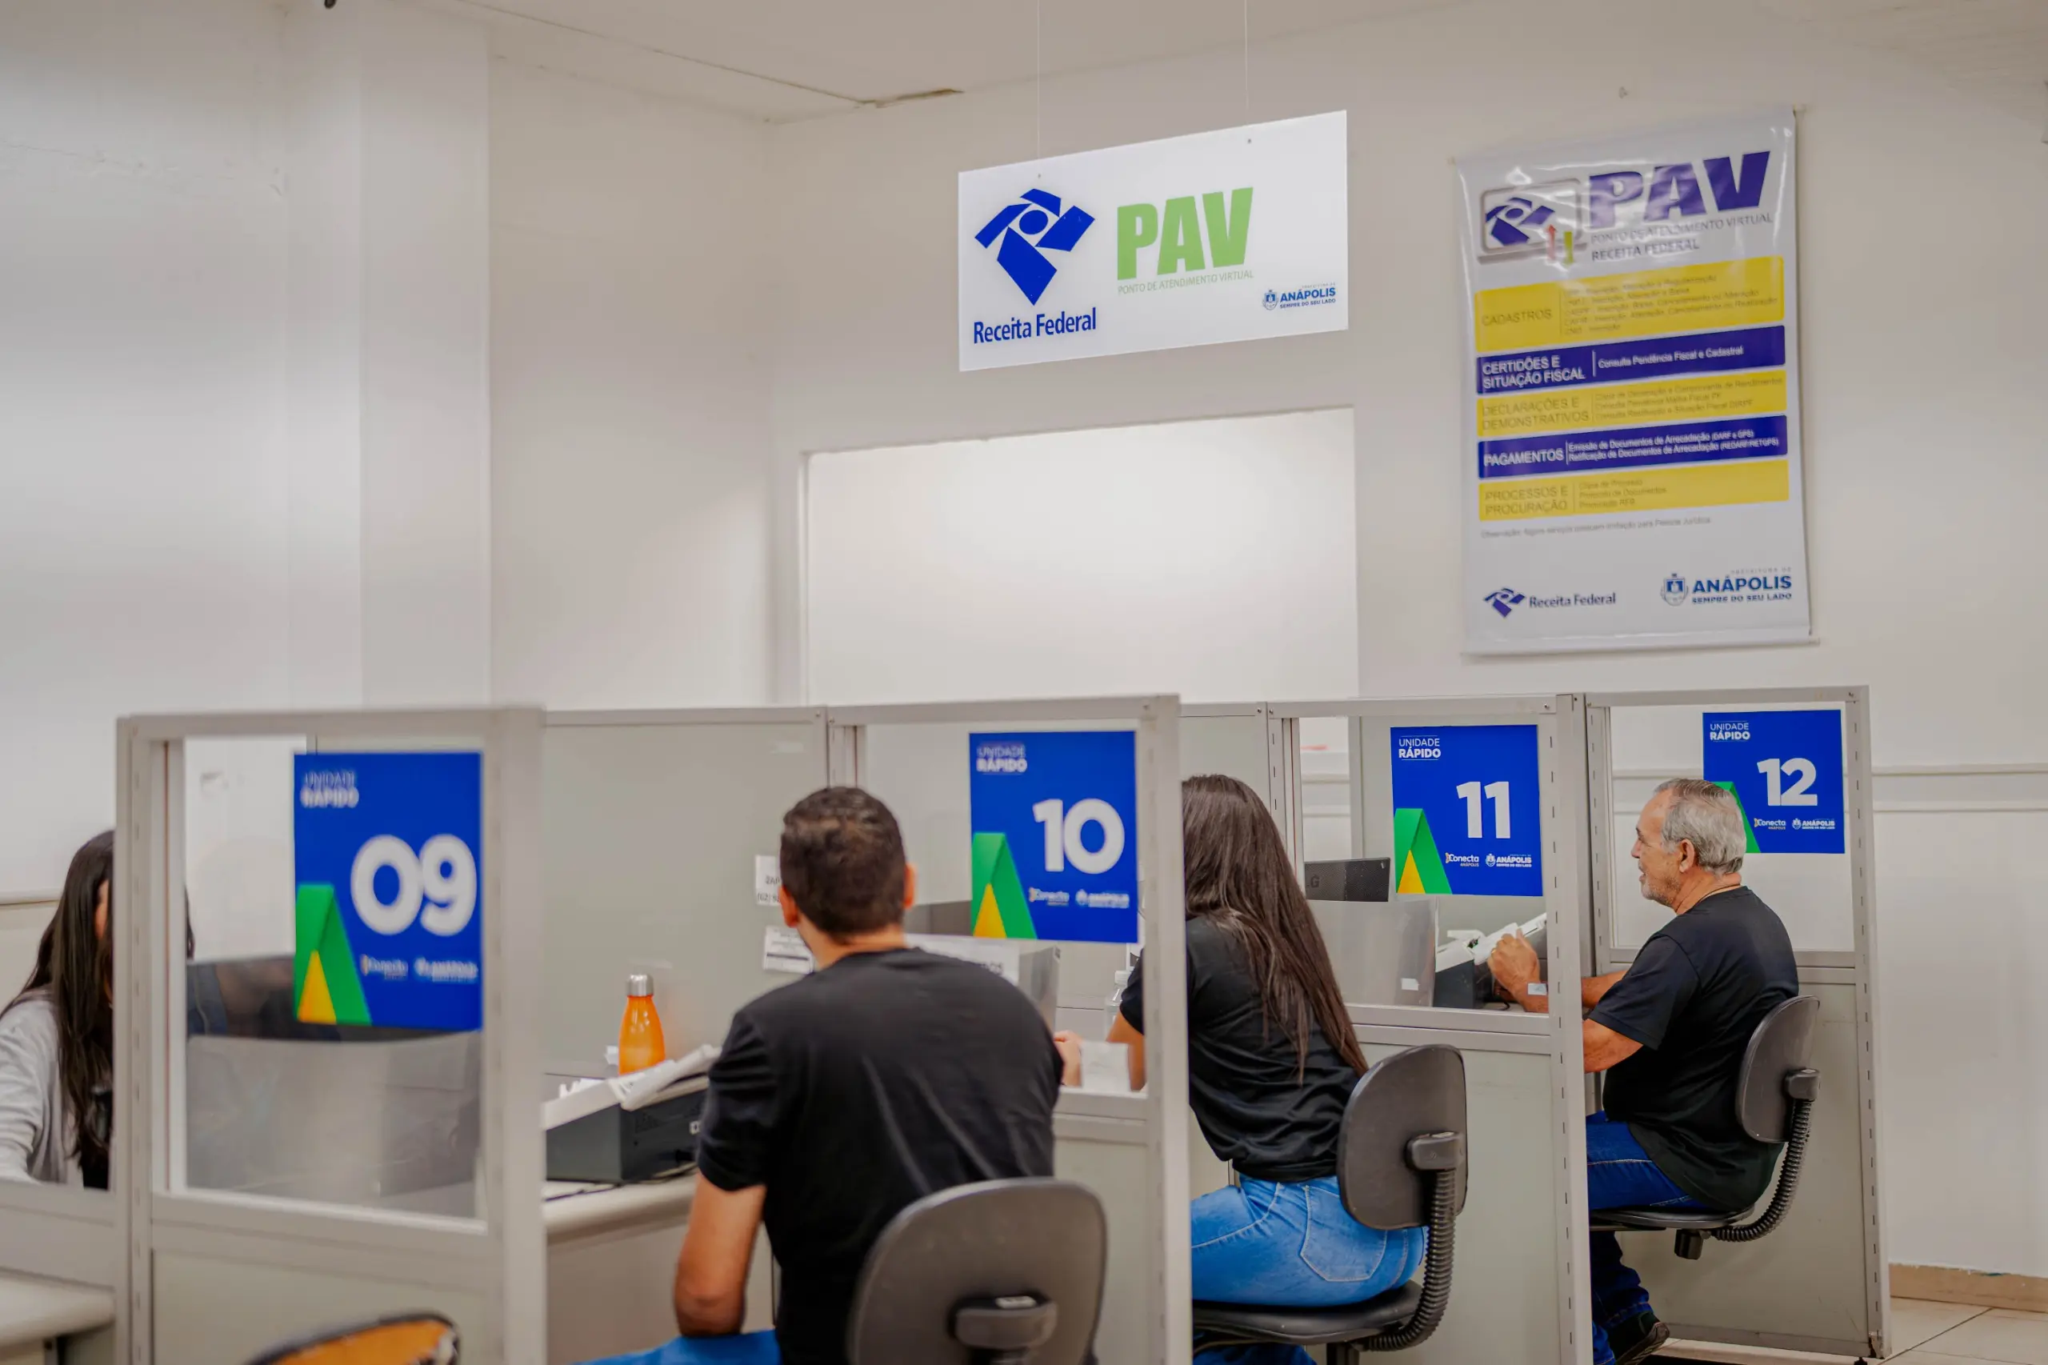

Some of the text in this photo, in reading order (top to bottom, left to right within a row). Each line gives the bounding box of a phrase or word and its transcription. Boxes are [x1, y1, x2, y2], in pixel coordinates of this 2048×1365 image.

[1589, 151, 1771, 230] PAV
[1725, 212, 1773, 227] VIRTUAL
[1117, 187, 1254, 281] PAV
[1592, 238, 1699, 261] RECEITA FEDERAL
[1118, 270, 1254, 295] PONTO DE ATENDIMENTO VIRTUAL
[1280, 287, 1336, 303] ANÁPOLIS
[973, 307, 1097, 344] Receita Federal
[1481, 309, 1553, 327] CADASTROS
[1482, 355, 1560, 375] CERTIDÕES E
[1483, 367, 1586, 388] SITUAÇÃO FISCAL
[1484, 397, 1579, 416] DECLARAÇÕES E
[1484, 410, 1589, 430] DEMONSTRATIVOS
[1484, 447, 1564, 466] PAGAMENTOS
[1485, 488, 1557, 501] PROCESSOS
[1560, 486, 1568, 497] E
[1485, 498, 1567, 516] PROCURAÇÃO
[1692, 574, 1792, 593] ANÁPOLIS
[1529, 592, 1616, 609] Receita Federal
[1692, 595, 1728, 604] SEMPRE
[1731, 594, 1744, 602] DO
[1767, 592, 1792, 601] LADO
[1709, 722, 1749, 731] UNIDADE
[1709, 730, 1751, 741] RÁPIDO
[977, 744, 1026, 758] UNIDADE
[1398, 738, 1440, 748] UNIDADE
[1398, 746, 1441, 759] RÁPIDO
[976, 757, 1028, 773] RÁPIDO
[1757, 757, 1818, 807] 12
[1456, 781, 1511, 839] 11
[1032, 798, 1126, 875] 10
[1449, 853, 1479, 862] Conecta
[1496, 855, 1532, 864] ANÁPOLIS
[350, 832, 478, 937] 09
